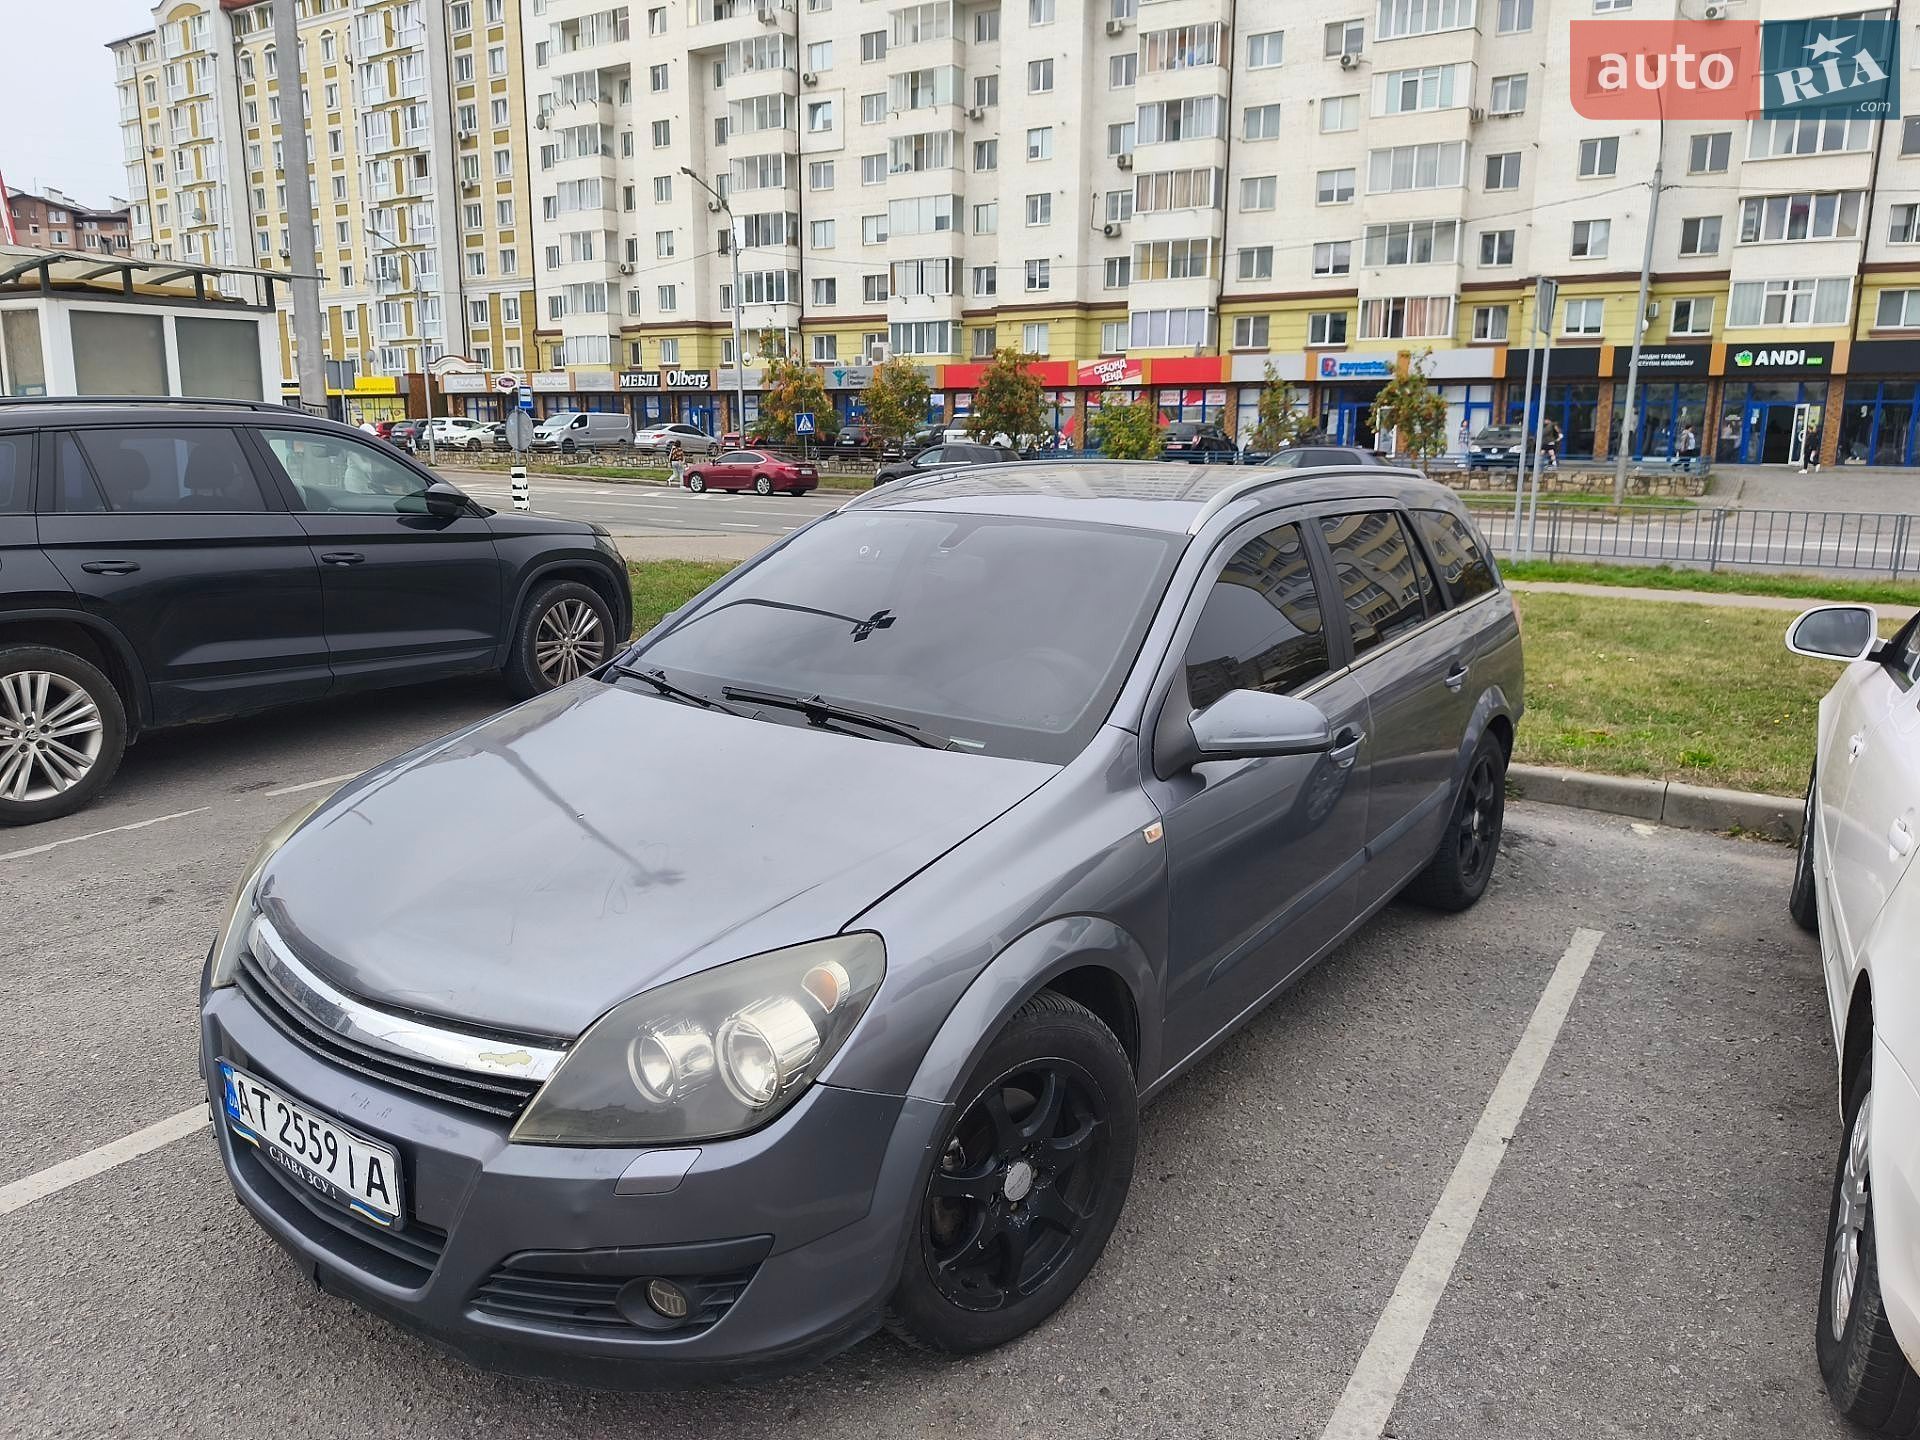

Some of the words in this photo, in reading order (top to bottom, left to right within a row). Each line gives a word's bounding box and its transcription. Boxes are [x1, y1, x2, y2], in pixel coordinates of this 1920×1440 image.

[1754, 349, 1806, 366] ANDI
[1093, 359, 1128, 375] СЕКОНД
[619, 374, 659, 387] МЕБЛІ
[666, 370, 709, 389] Olberg
[1100, 370, 1124, 384] ХЕНД
[229, 1091, 240, 1110] UA
[237, 1079, 271, 1132] AT
[277, 1102, 338, 1174] 2559
[269, 1146, 306, 1180] СЛАВА
[307, 1171, 331, 1192] ЗСУ
